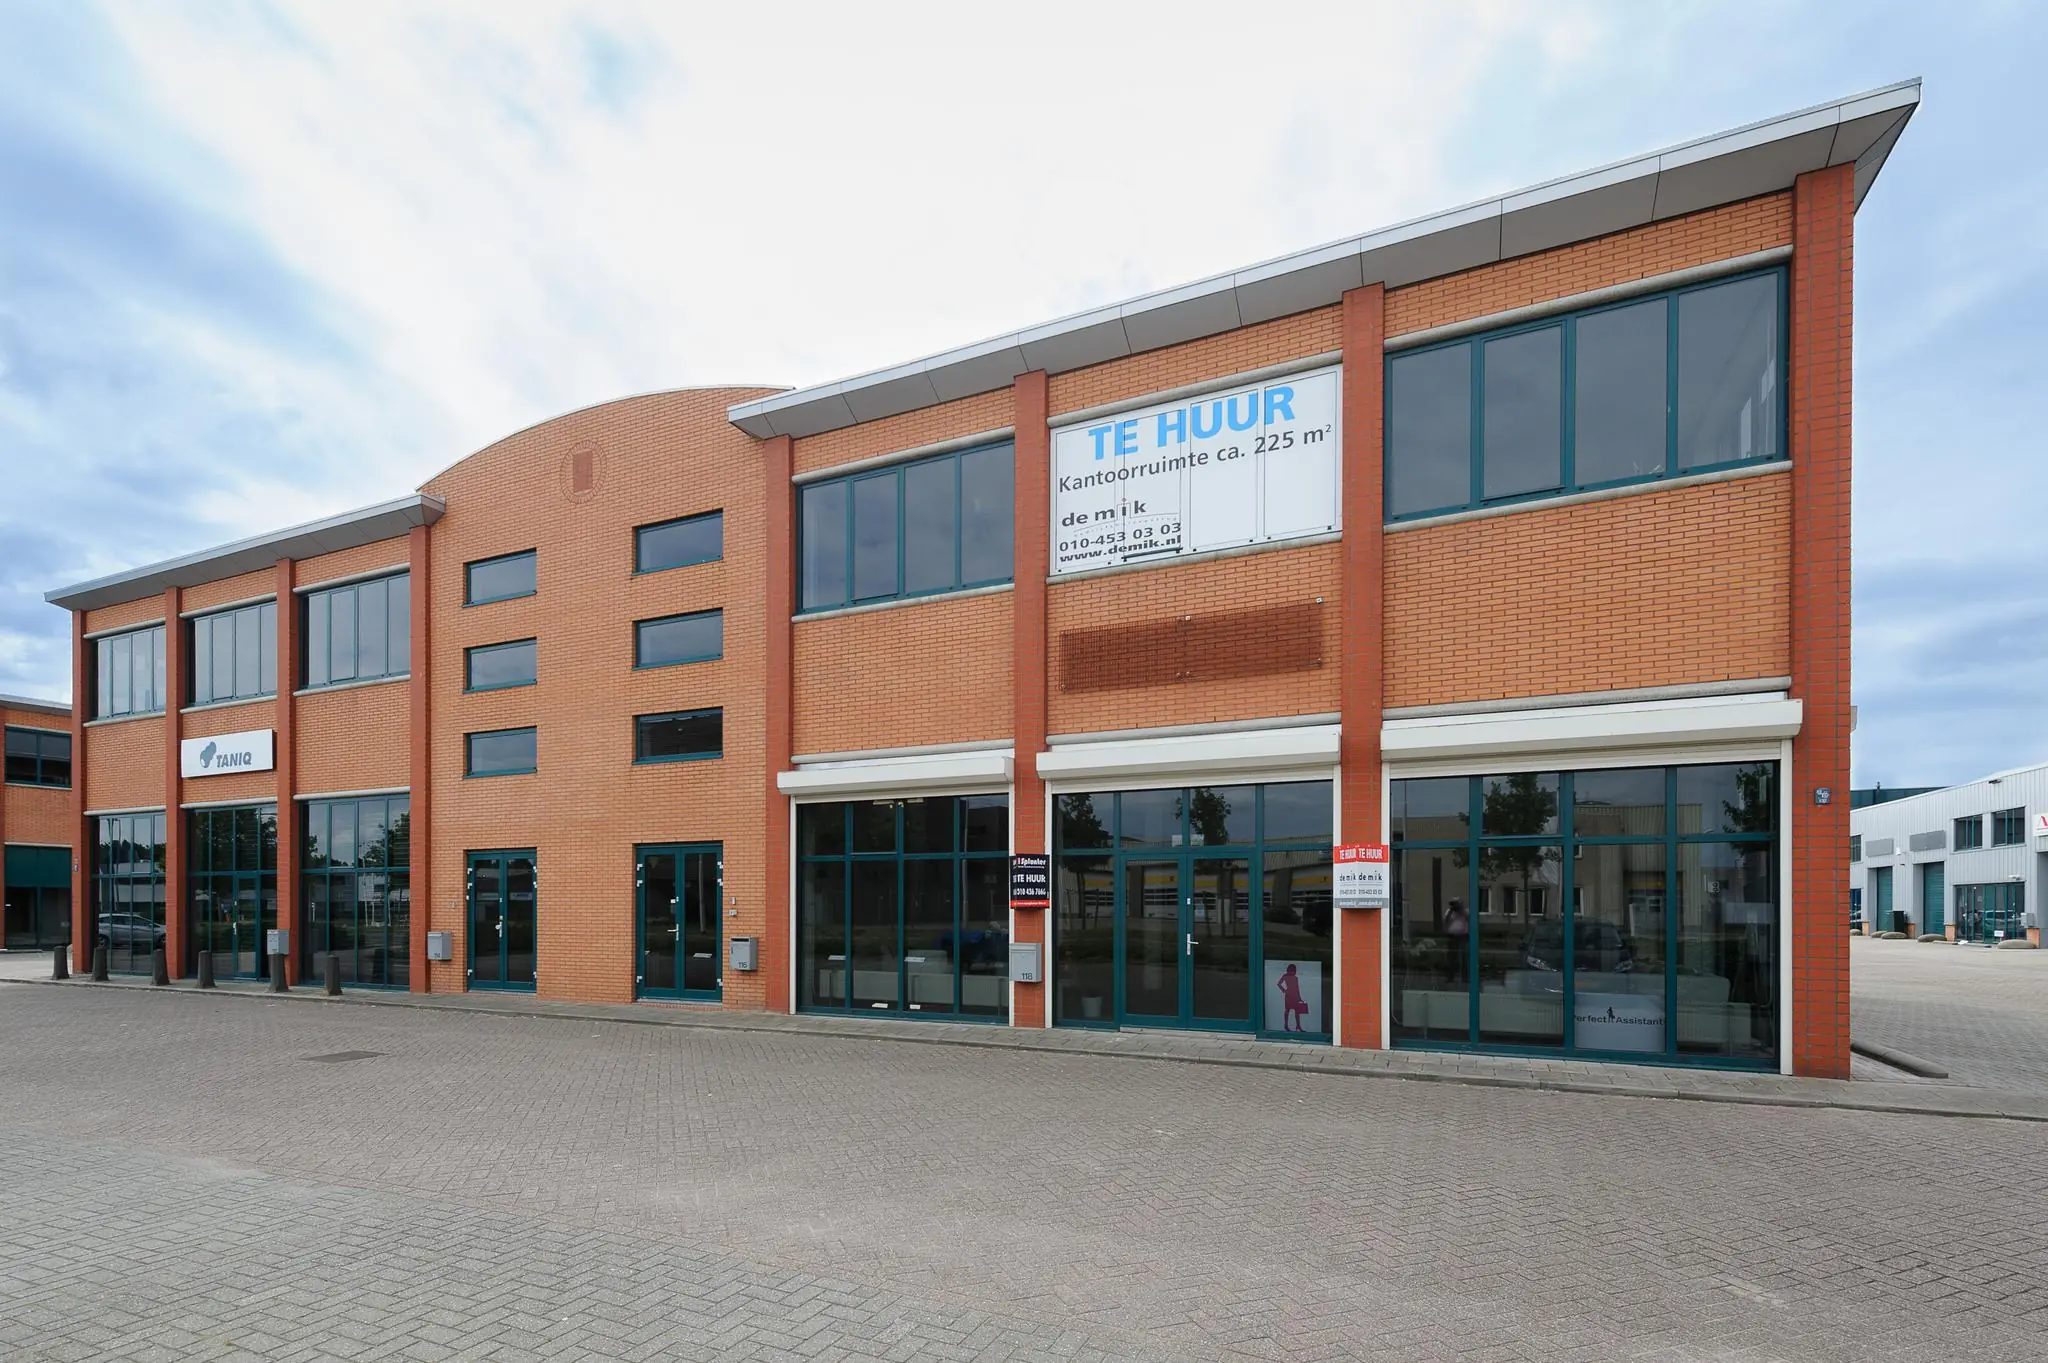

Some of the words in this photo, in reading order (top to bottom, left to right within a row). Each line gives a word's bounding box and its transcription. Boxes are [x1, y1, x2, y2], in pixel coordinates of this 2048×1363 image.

[1088, 419, 1140, 460] TE
[1157, 386, 1296, 448] HUUR
[1059, 451, 1209, 493] Kantoorruimte
[1217, 445, 1245, 462] ca.
[1254, 430, 1294, 454] 225
[1061, 512, 1088, 527] de
[1059, 531, 1126, 552] 010-453
[1133, 527, 1153, 540] 03
[1160, 522, 1181, 535] 03
[1059, 535, 1181, 562] www.demik.nl
[216, 751, 252, 768] TANIQ
[1358, 848, 1365, 859] TE
[1366, 848, 1383, 860] HUUR
[1017, 874, 1025, 883] TE
[1026, 874, 1046, 883] HUUR
[1022, 972, 1033, 980] 118
